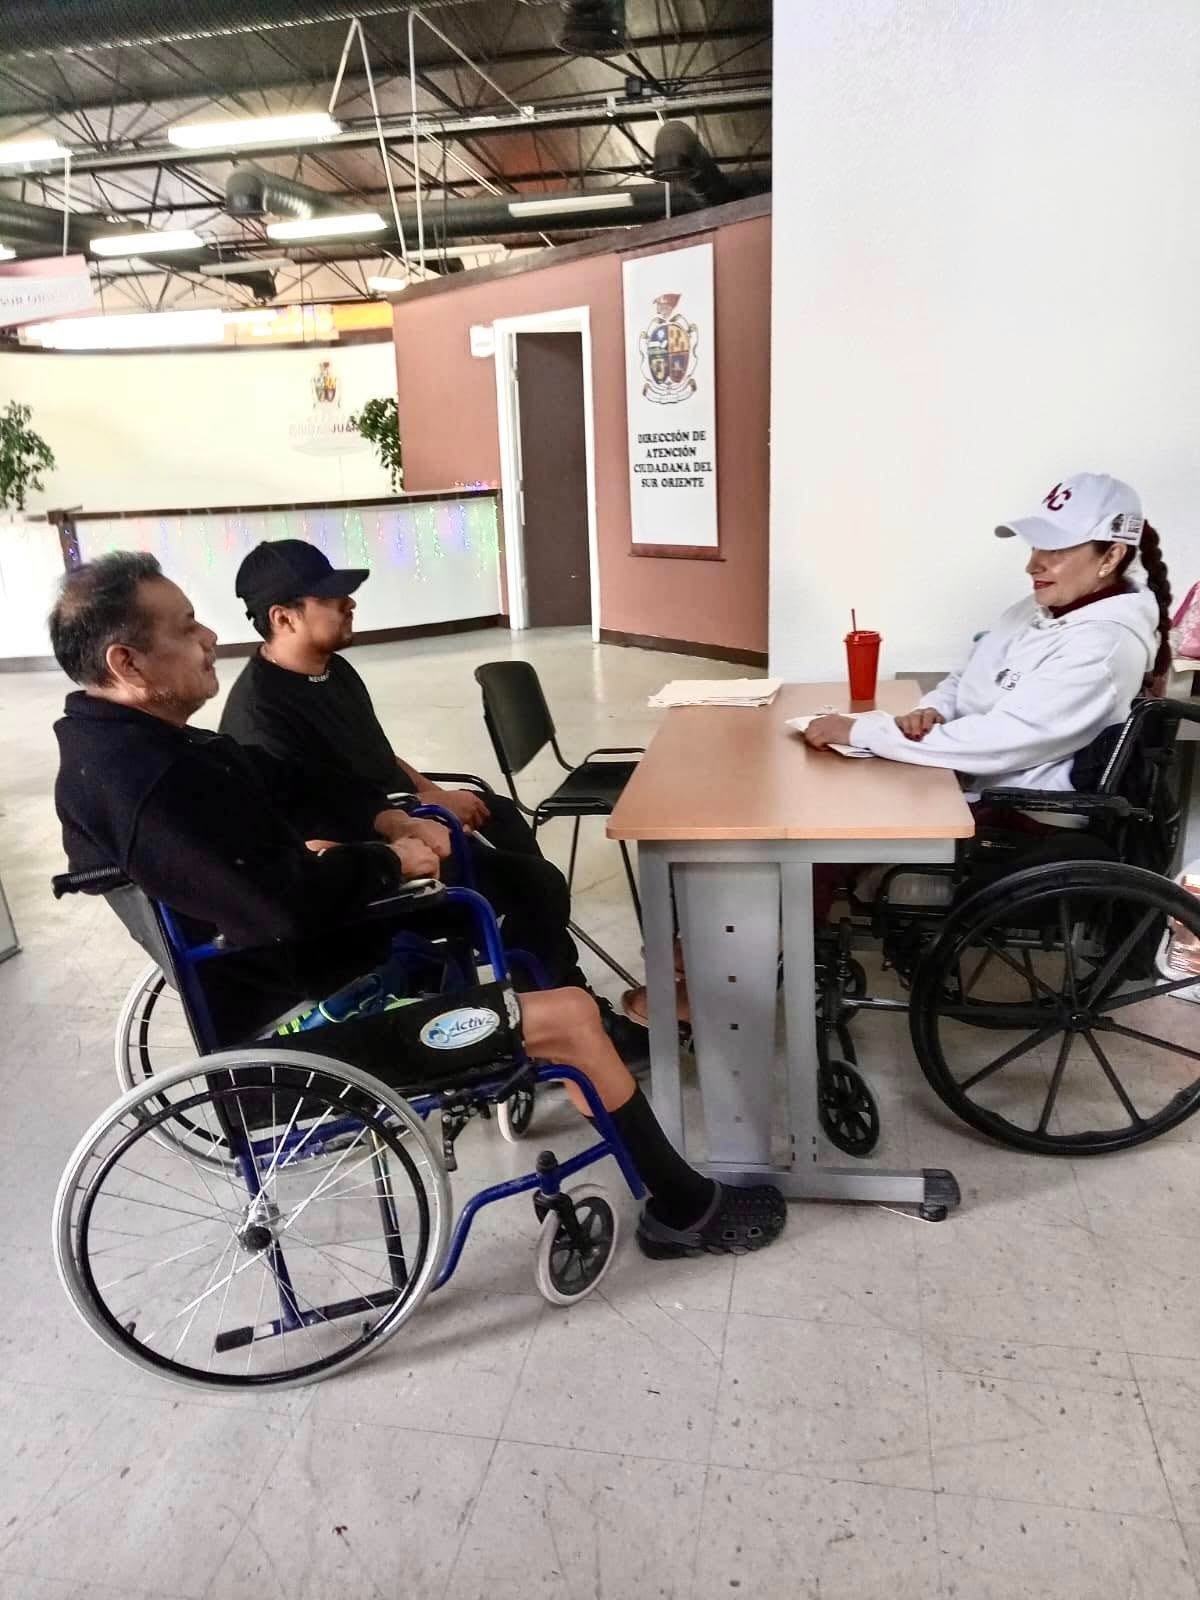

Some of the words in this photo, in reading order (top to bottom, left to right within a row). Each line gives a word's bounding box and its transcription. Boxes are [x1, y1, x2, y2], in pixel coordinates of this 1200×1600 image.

[638, 430, 689, 443] DIRECCIÓN
[693, 431, 706, 441] DE
[646, 445, 696, 458] ATENCIÓN
[634, 463, 691, 472] CIUDADANA
[694, 462, 712, 472] DEL
[641, 479, 658, 487] SUR
[661, 478, 704, 487] ORIENTE
